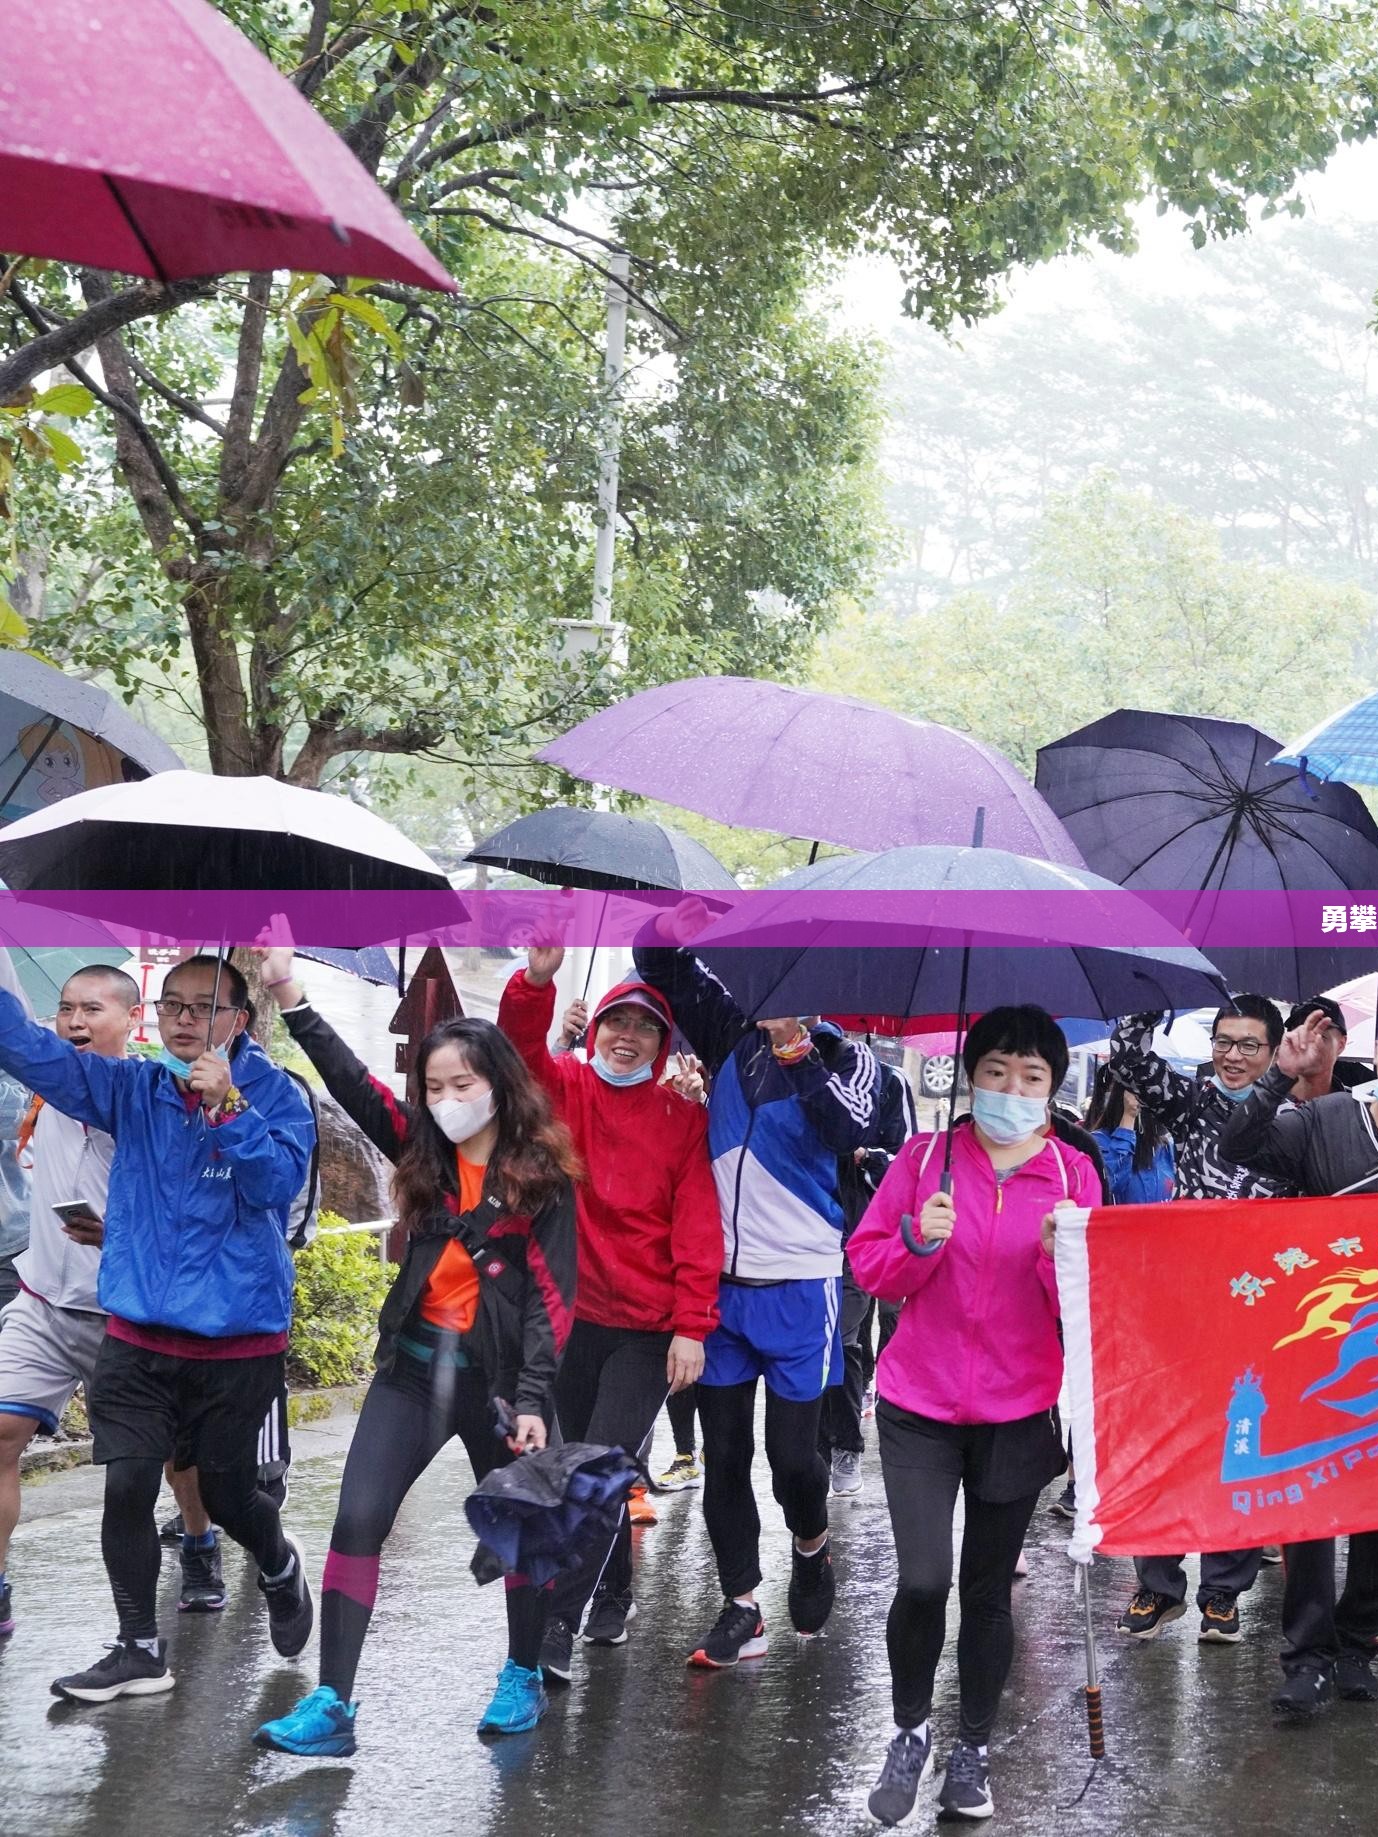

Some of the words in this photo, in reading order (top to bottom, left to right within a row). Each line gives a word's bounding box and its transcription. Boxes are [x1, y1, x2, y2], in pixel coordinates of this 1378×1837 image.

[1234, 1417, 1253, 1456] 清溪
[1231, 1483, 1304, 1515] Qing
[1306, 1461, 1340, 1489] Xi
